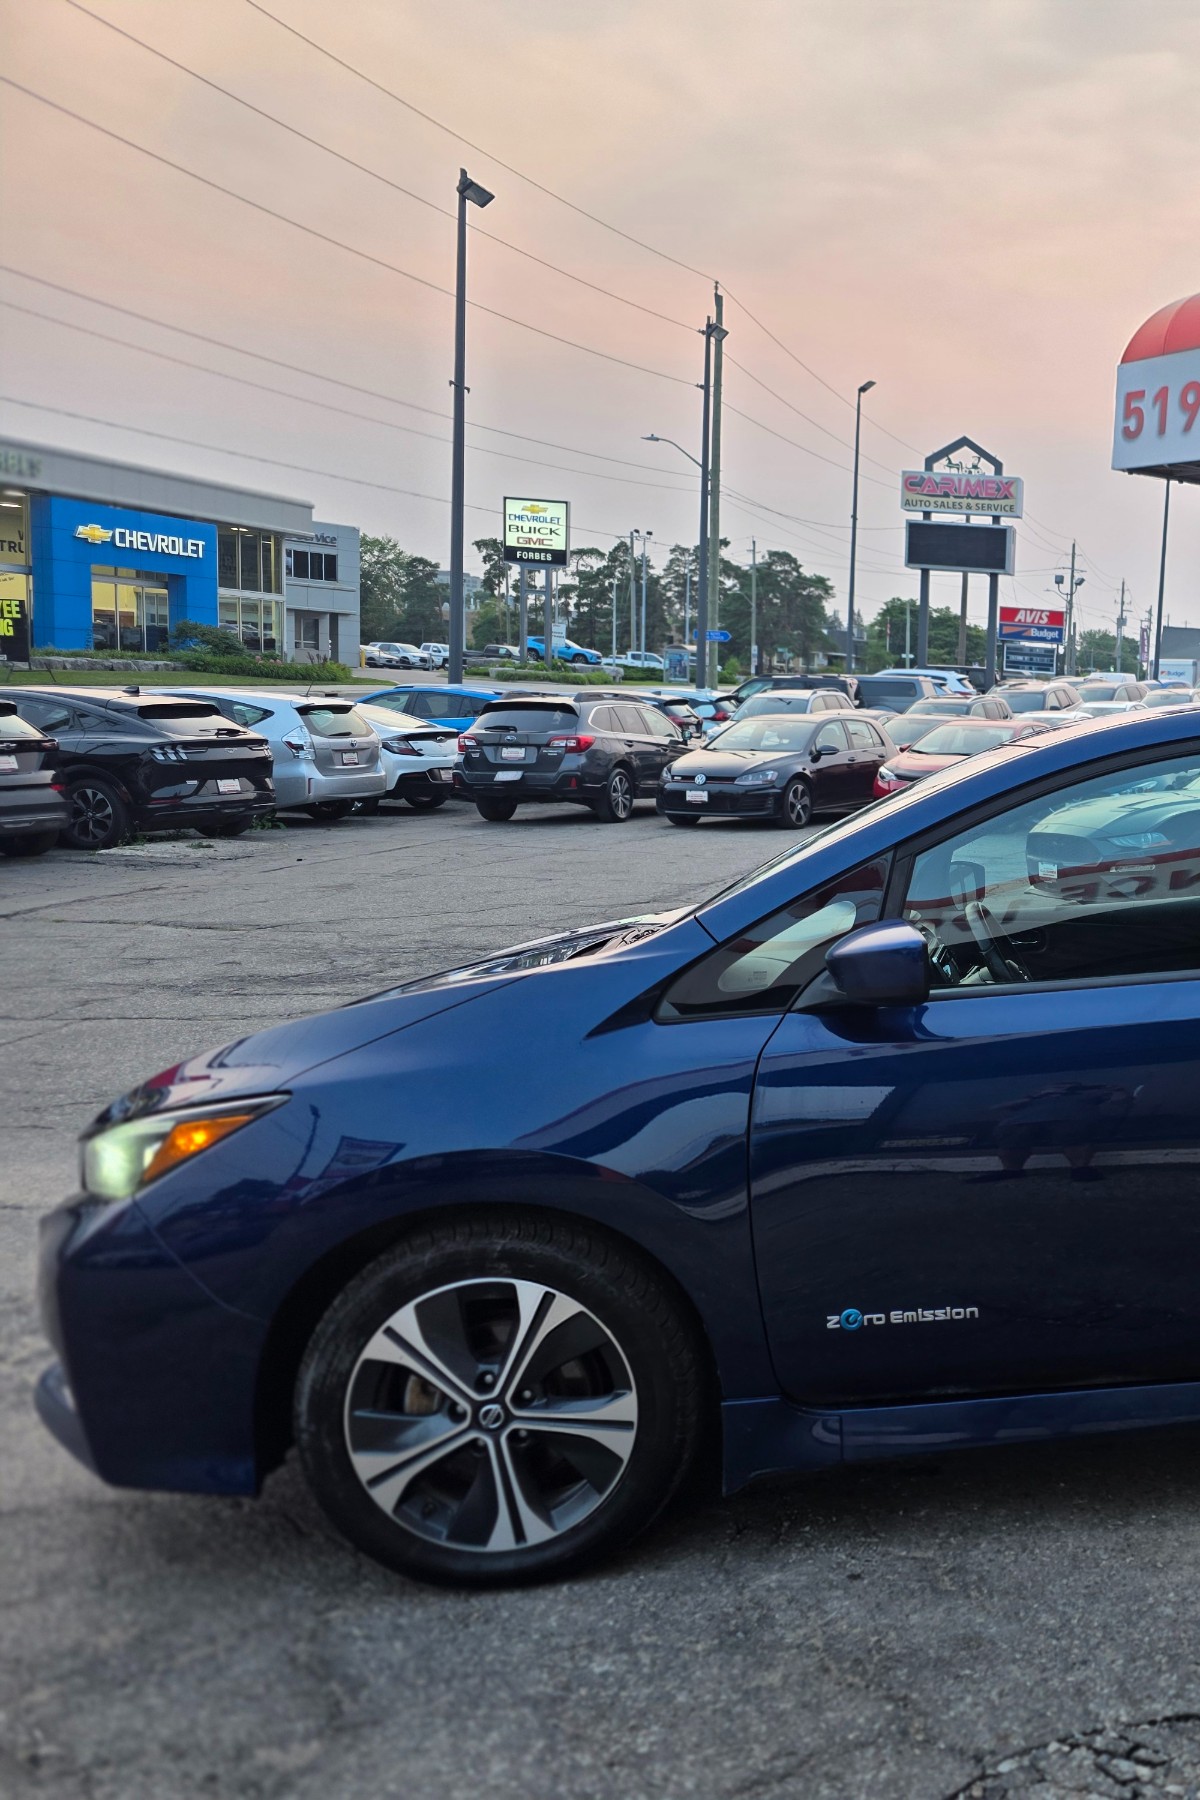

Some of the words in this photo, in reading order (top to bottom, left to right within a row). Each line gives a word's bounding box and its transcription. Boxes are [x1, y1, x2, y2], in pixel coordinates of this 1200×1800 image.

[904, 475, 1016, 498] CARIMEX
[904, 498, 931, 508] AUTO
[934, 500, 963, 510] SALES
[966, 503, 973, 511] &
[975, 503, 1015, 513] SERVICE
[508, 513, 561, 525] CHEVROLET
[508, 525, 561, 536] BUICK
[115, 527, 205, 559] CHEVROLET
[517, 536, 553, 547] GMC
[517, 551, 552, 561] FORBES
[1014, 609, 1050, 624] AVIS
[1031, 628, 1059, 640] Budget
[890, 1307, 979, 1324] Emission
